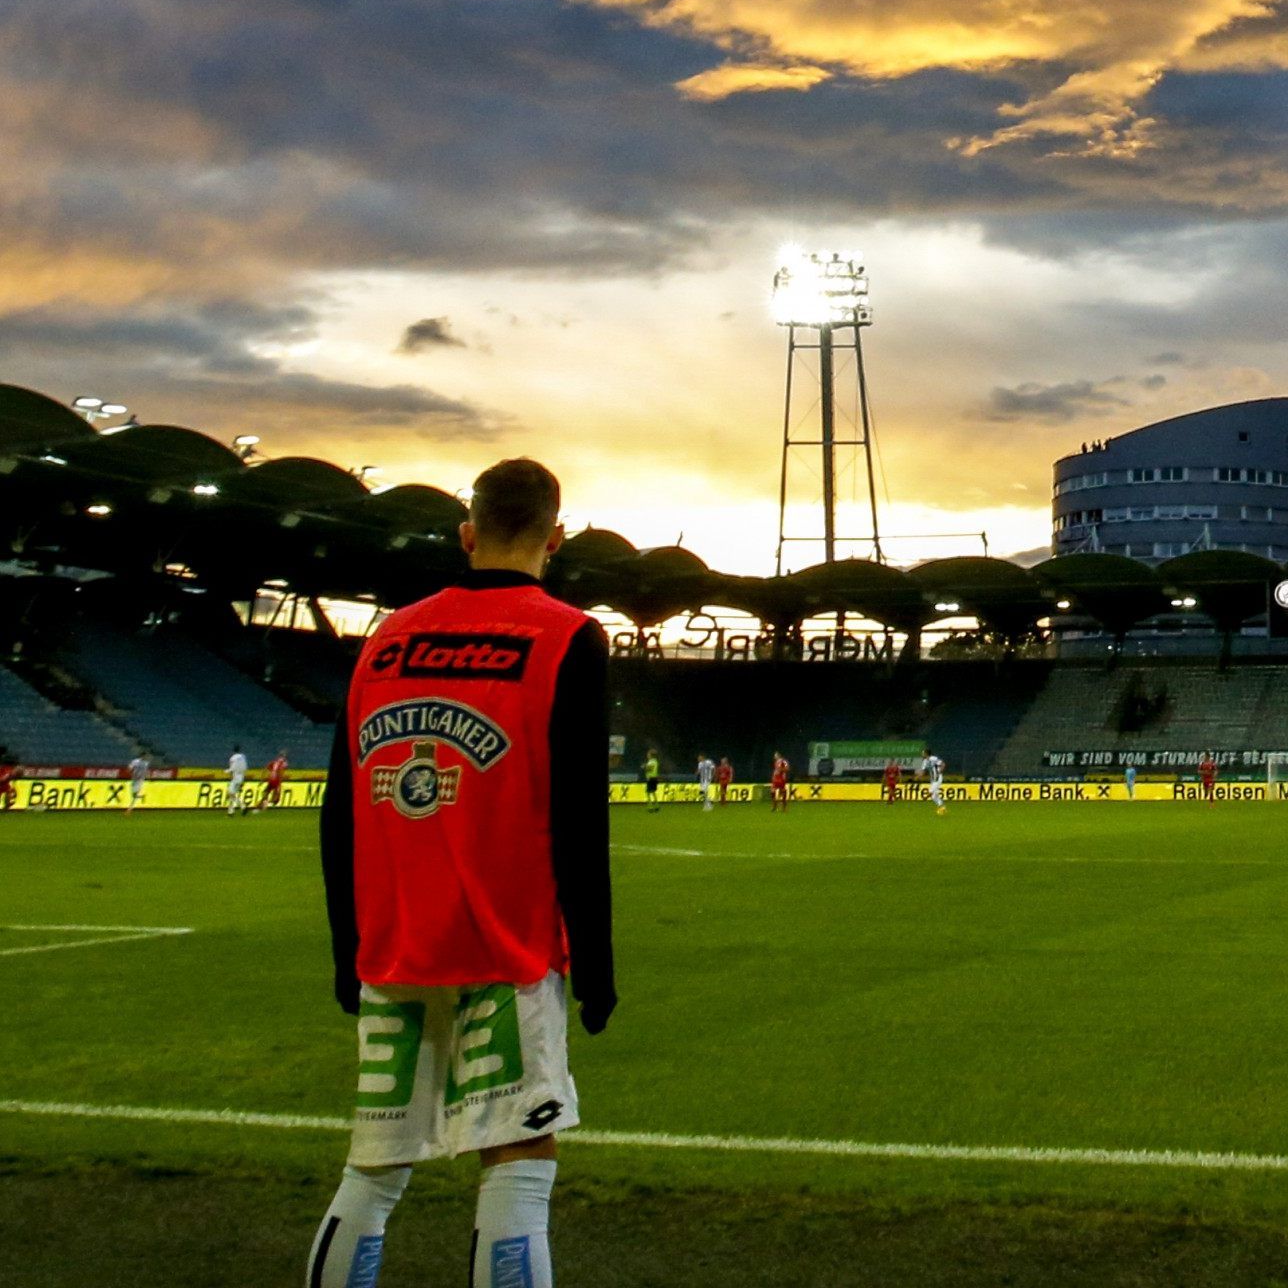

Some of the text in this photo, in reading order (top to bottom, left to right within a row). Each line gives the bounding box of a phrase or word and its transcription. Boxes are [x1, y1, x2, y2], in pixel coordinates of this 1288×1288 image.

[359, 707, 500, 760] PUNTIGAMER
[1081, 752, 1113, 765] SIND
[1119, 752, 1146, 765] VOM
[980, 783, 1032, 799] Meine
[1040, 783, 1090, 799] Bank.
